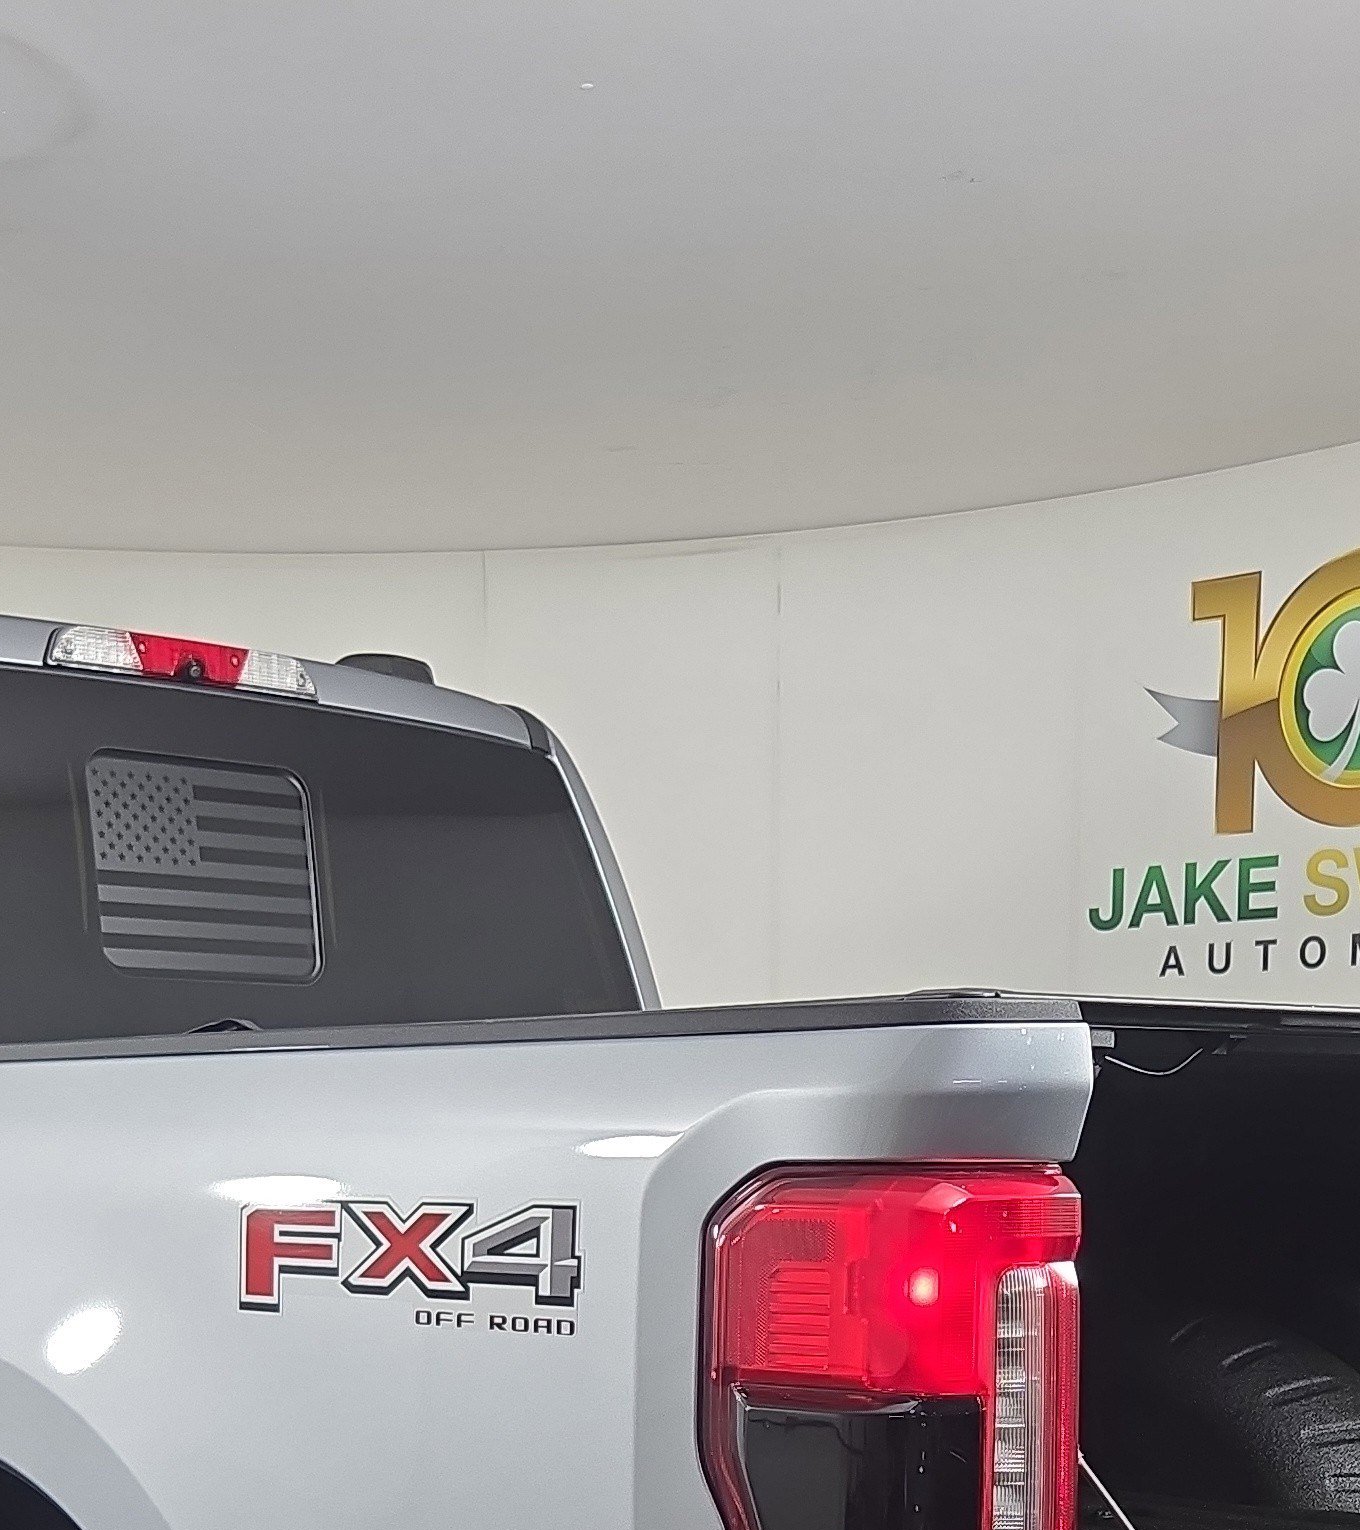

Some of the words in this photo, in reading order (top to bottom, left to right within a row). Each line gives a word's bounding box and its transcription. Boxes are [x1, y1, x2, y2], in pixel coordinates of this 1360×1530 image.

[1087, 853, 1281, 932] JAKE
[239, 1200, 582, 1313] FX4
[414, 1309, 475, 1330] OFF
[488, 1313, 578, 1337] ROAD
